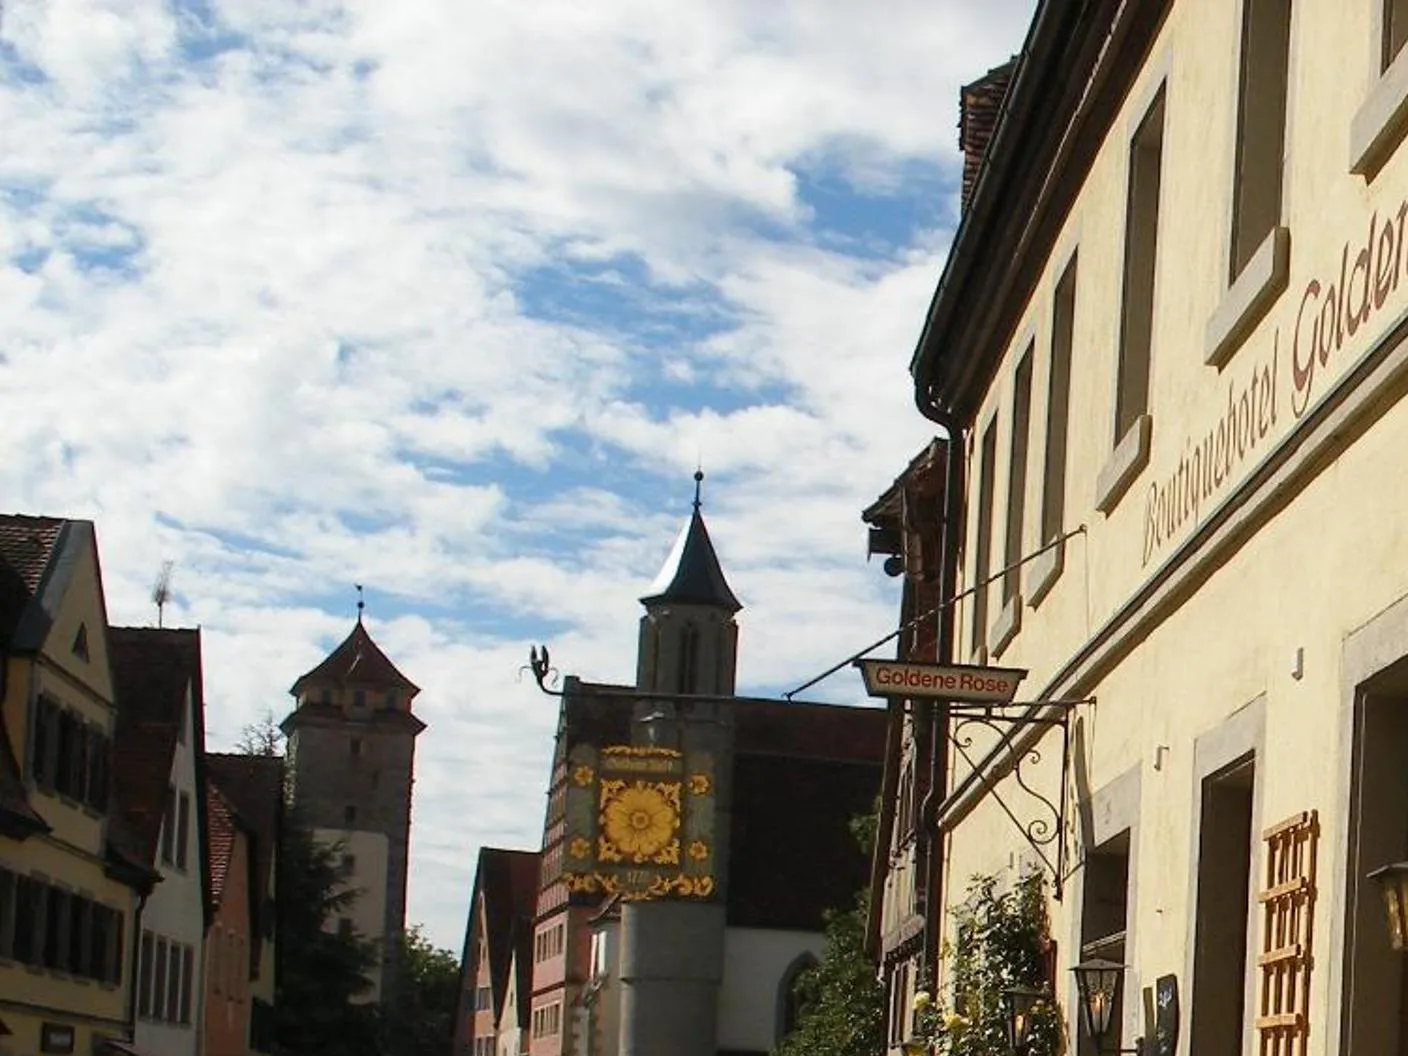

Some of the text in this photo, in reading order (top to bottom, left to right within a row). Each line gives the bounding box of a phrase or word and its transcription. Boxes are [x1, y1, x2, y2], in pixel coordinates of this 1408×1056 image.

[1142, 326, 1280, 569] Boutiquehotel
[875, 667, 1009, 694] Goldene Rose
